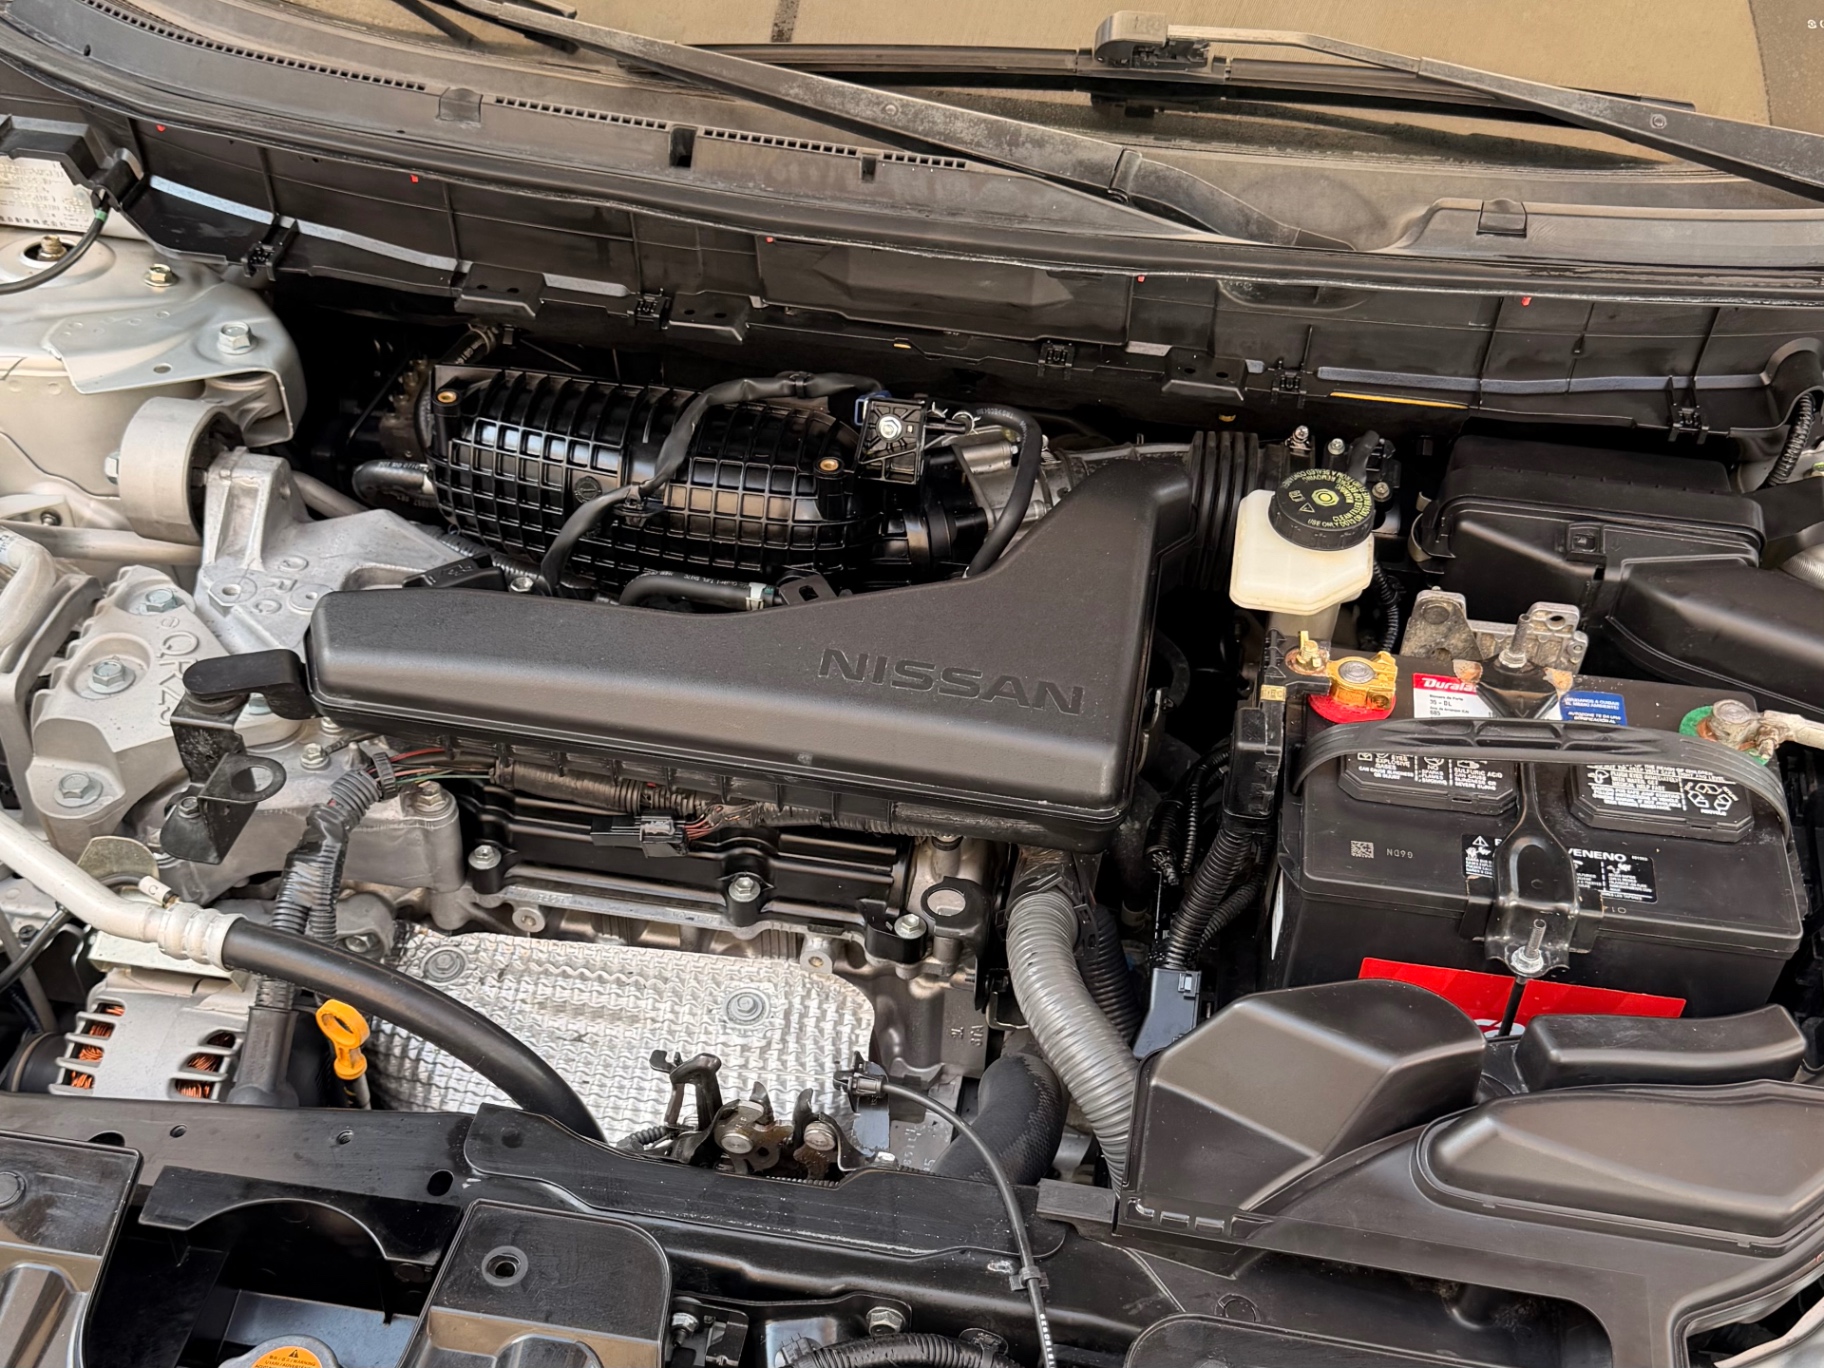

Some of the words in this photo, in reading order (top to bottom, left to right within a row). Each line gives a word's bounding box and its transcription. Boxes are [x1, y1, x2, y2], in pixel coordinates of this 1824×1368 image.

[818, 648, 1085, 716] NISSAN
[1454, 767, 1486, 776] SULFURIC
[1487, 771, 1503, 779] ACID
